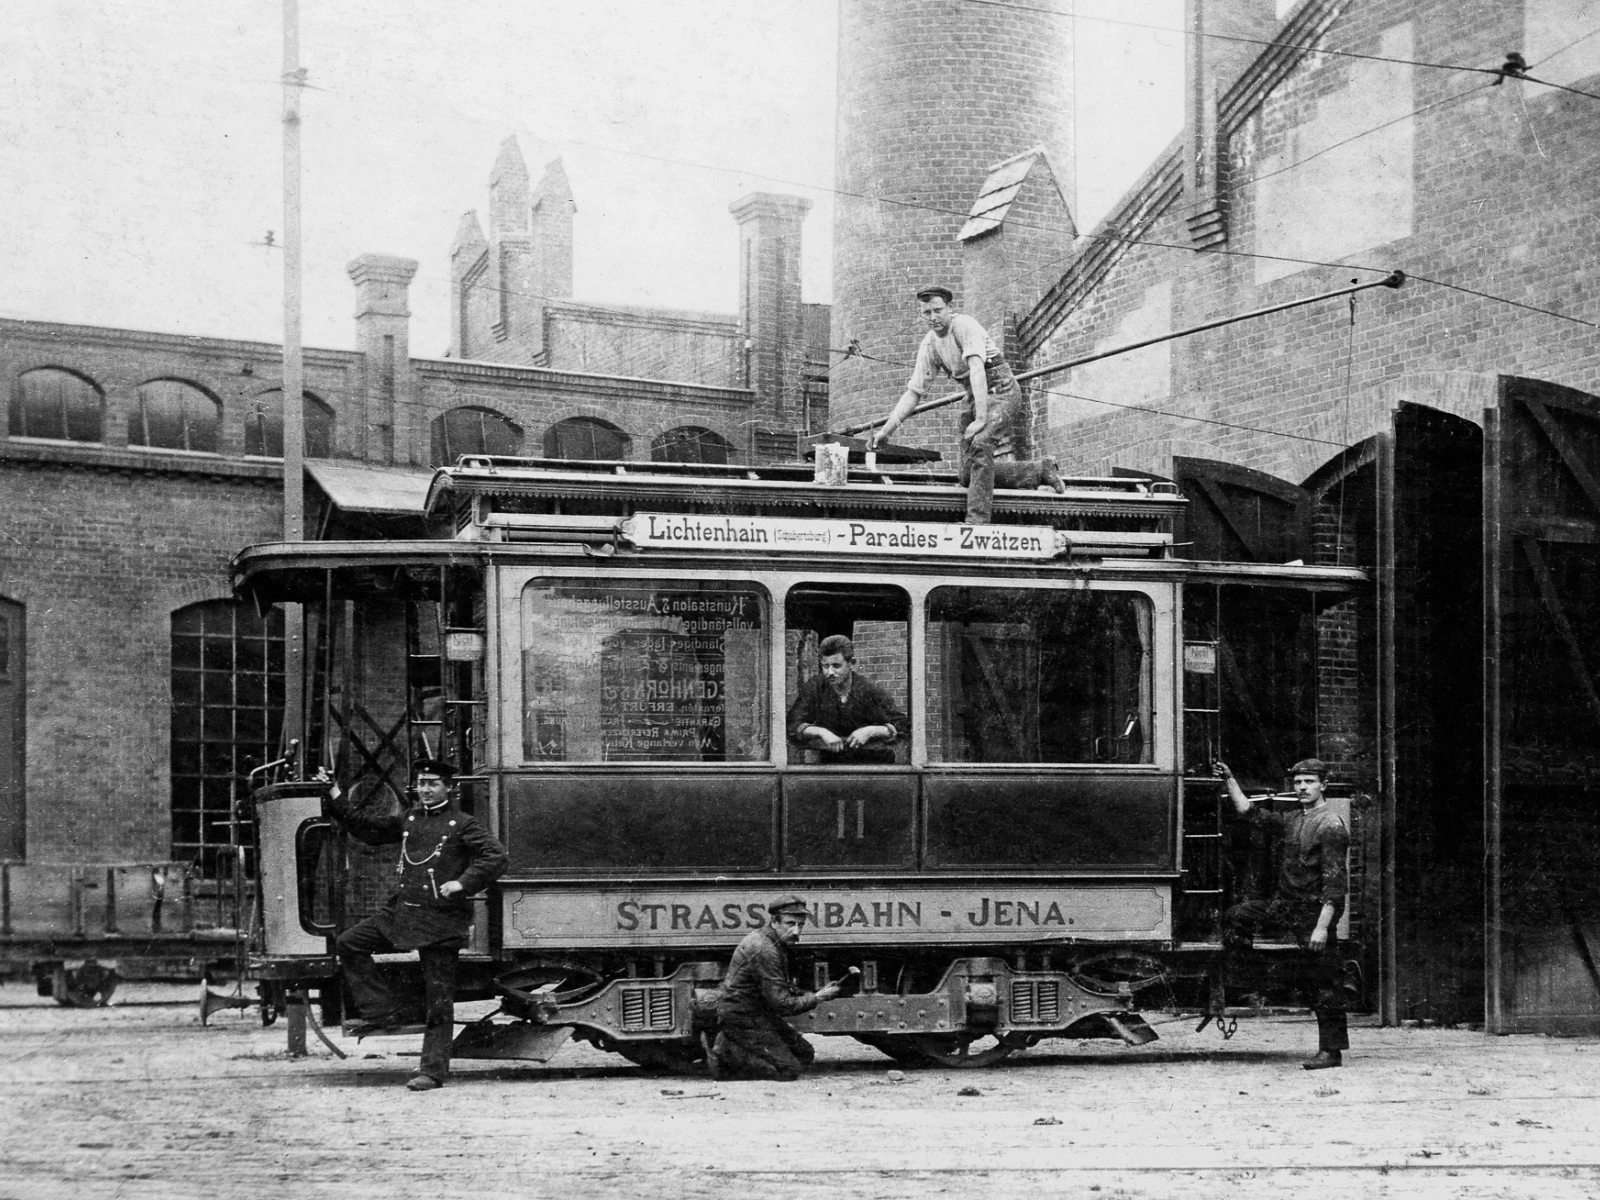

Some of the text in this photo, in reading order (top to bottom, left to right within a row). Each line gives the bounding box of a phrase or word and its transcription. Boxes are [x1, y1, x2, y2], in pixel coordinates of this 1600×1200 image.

[648, 516, 768, 543] Lichtenhain
[849, 523, 938, 548] Paradies
[960, 527, 1042, 551] Zwätzen
[617, 900, 922, 930] STRASSNBAHN
[968, 898, 1075, 926] JENA.
